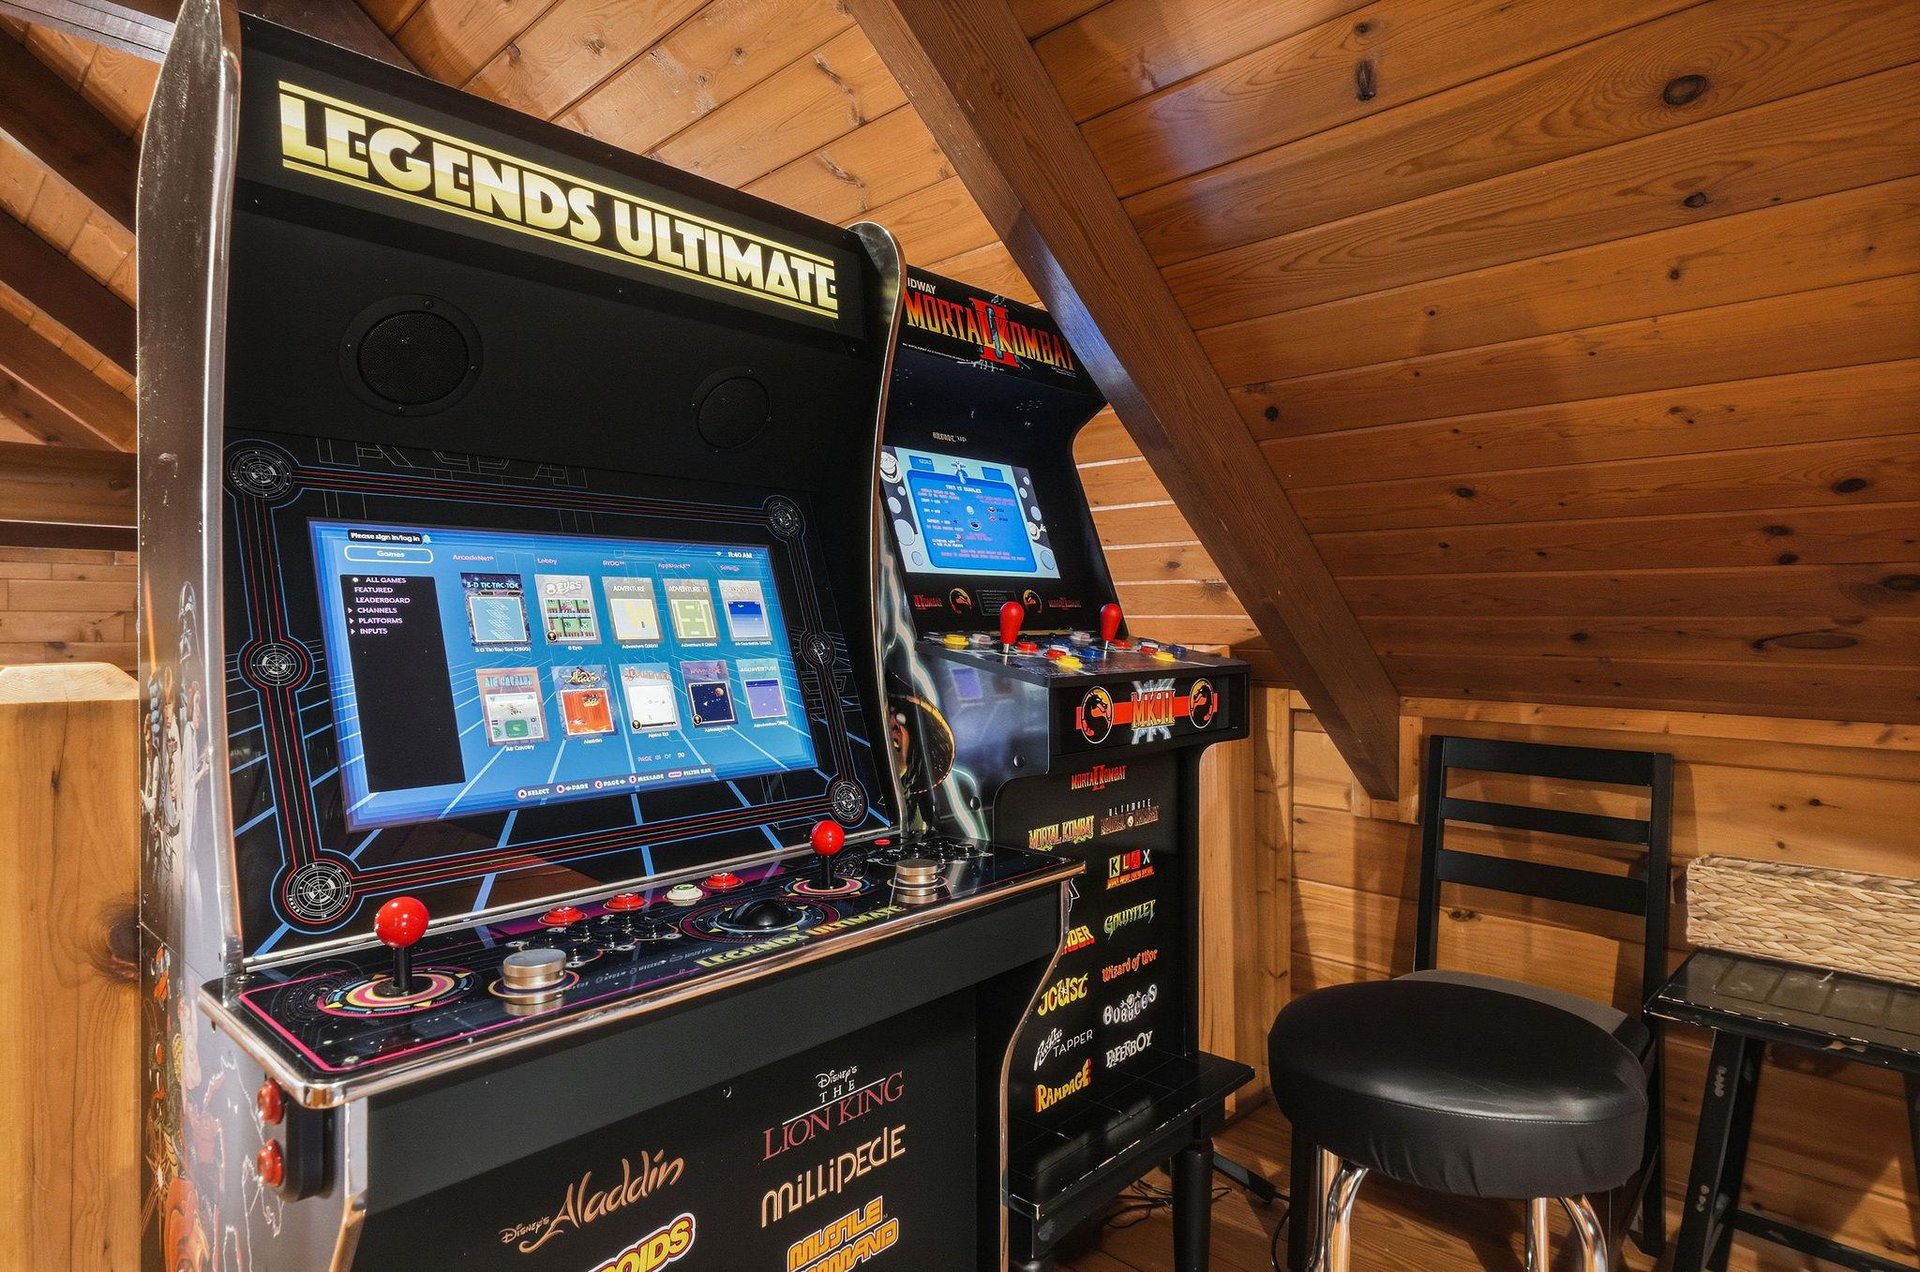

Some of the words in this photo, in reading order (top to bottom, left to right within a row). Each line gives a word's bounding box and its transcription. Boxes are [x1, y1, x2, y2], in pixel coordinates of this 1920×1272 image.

[279, 92, 601, 243] LEGENDS
[614, 199, 838, 310] ULTIMATE
[907, 277, 936, 294] IDWAY
[904, 288, 995, 350] MORTAL
[376, 550, 405, 558] Games
[527, 788, 550, 796] SELECT
[1028, 823, 1061, 850] MORTAL
[1061, 815, 1095, 842] KOMBAT
[1103, 899, 1156, 940] GAUNTLET
[694, 932, 809, 967] LEGENDS
[1102, 964, 1131, 983] Wizard
[1131, 953, 1141, 971] of
[1052, 1029, 1093, 1058] TAPPER
[1105, 1031, 1153, 1068] PAPERBOY
[819, 1079, 855, 1103] THE
[1035, 1058, 1093, 1113] RAMPAGE
[762, 1105, 831, 1161] LION
[838, 1071, 905, 1126] KING
[518, 1149, 686, 1254] Aladdin
[592, 1211, 697, 1272] OIDS
[787, 1195, 883, 1272] MISSILE
